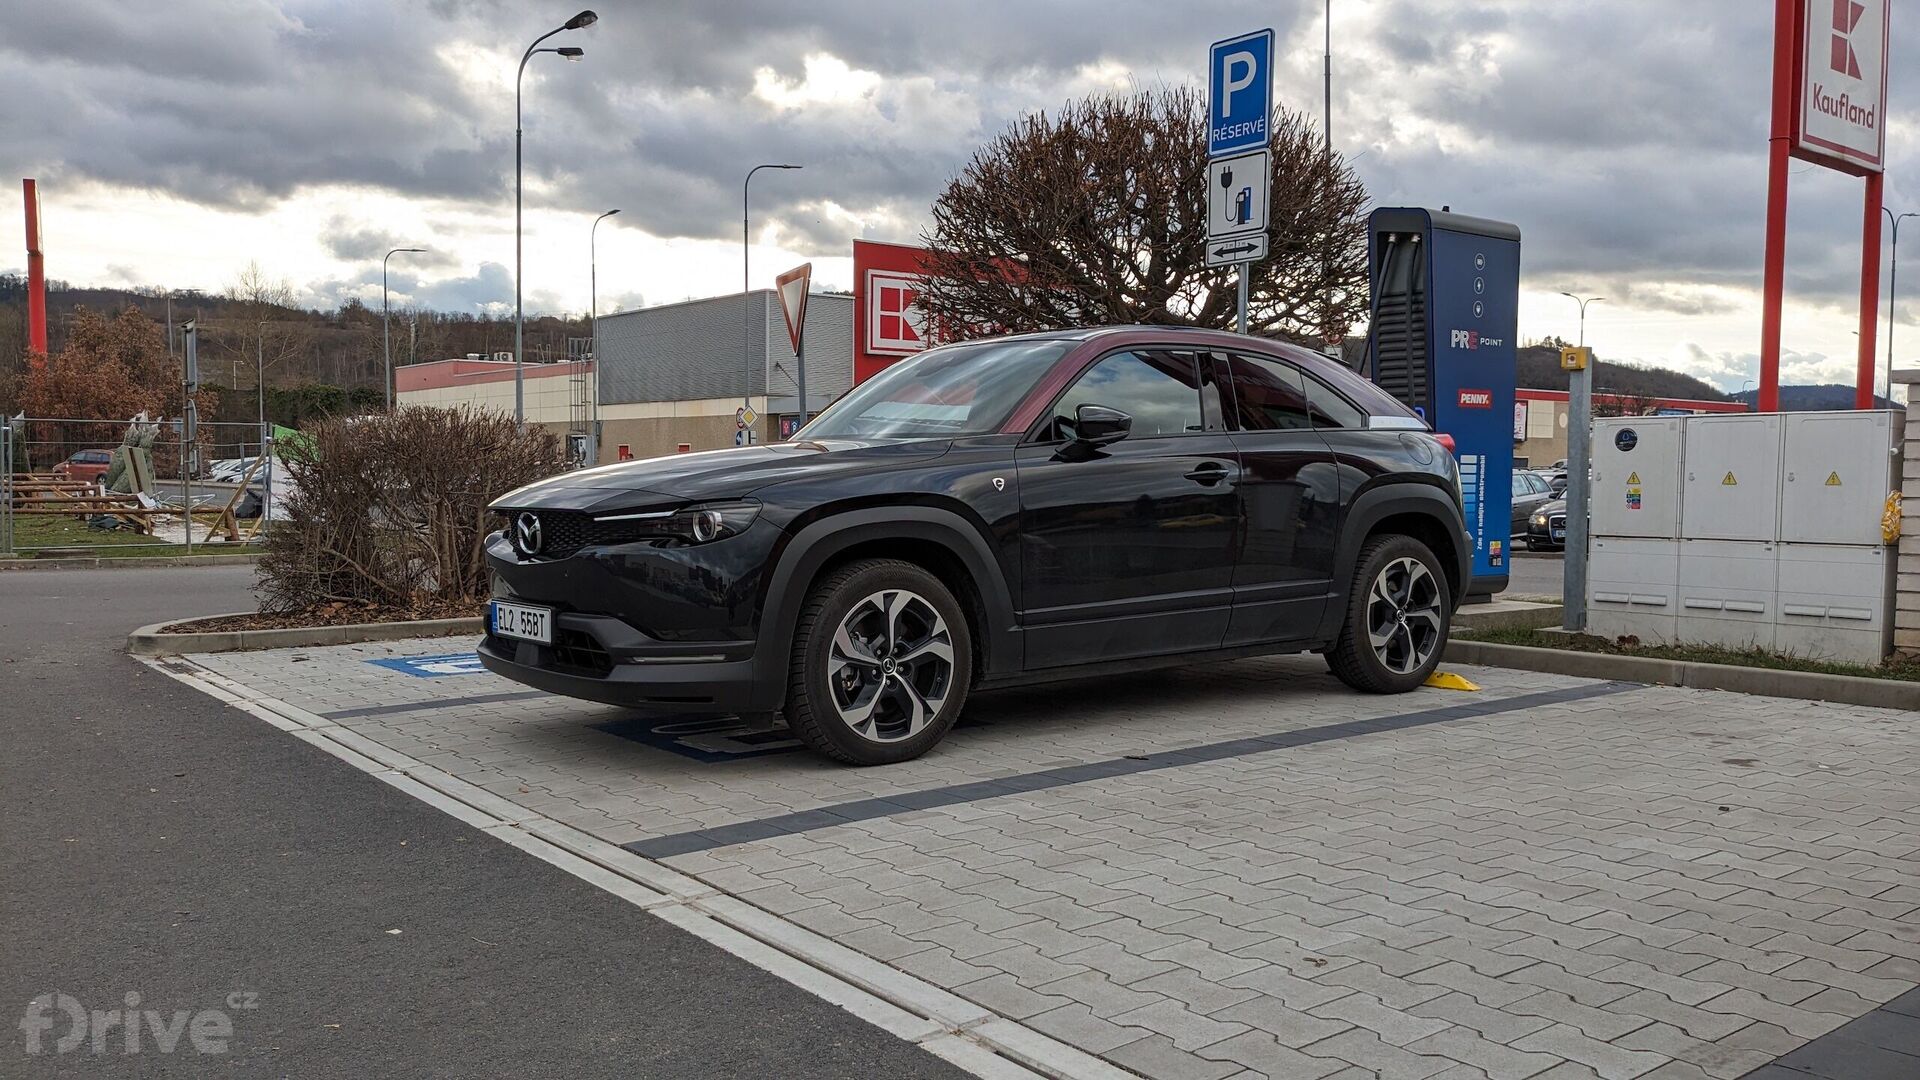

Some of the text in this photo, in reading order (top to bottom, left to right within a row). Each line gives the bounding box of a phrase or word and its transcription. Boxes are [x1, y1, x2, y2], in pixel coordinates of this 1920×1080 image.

[1222, 50, 1257, 118] P
[1812, 82, 1875, 129] Kaufland
[1212, 115, 1265, 142] RÉSERVÉ
[1450, 329, 1503, 350] PRE POINT
[1478, 455, 1486, 501] elektromobil
[1477, 528, 1483, 536] si
[498, 607, 545, 637] EL2 55BT
